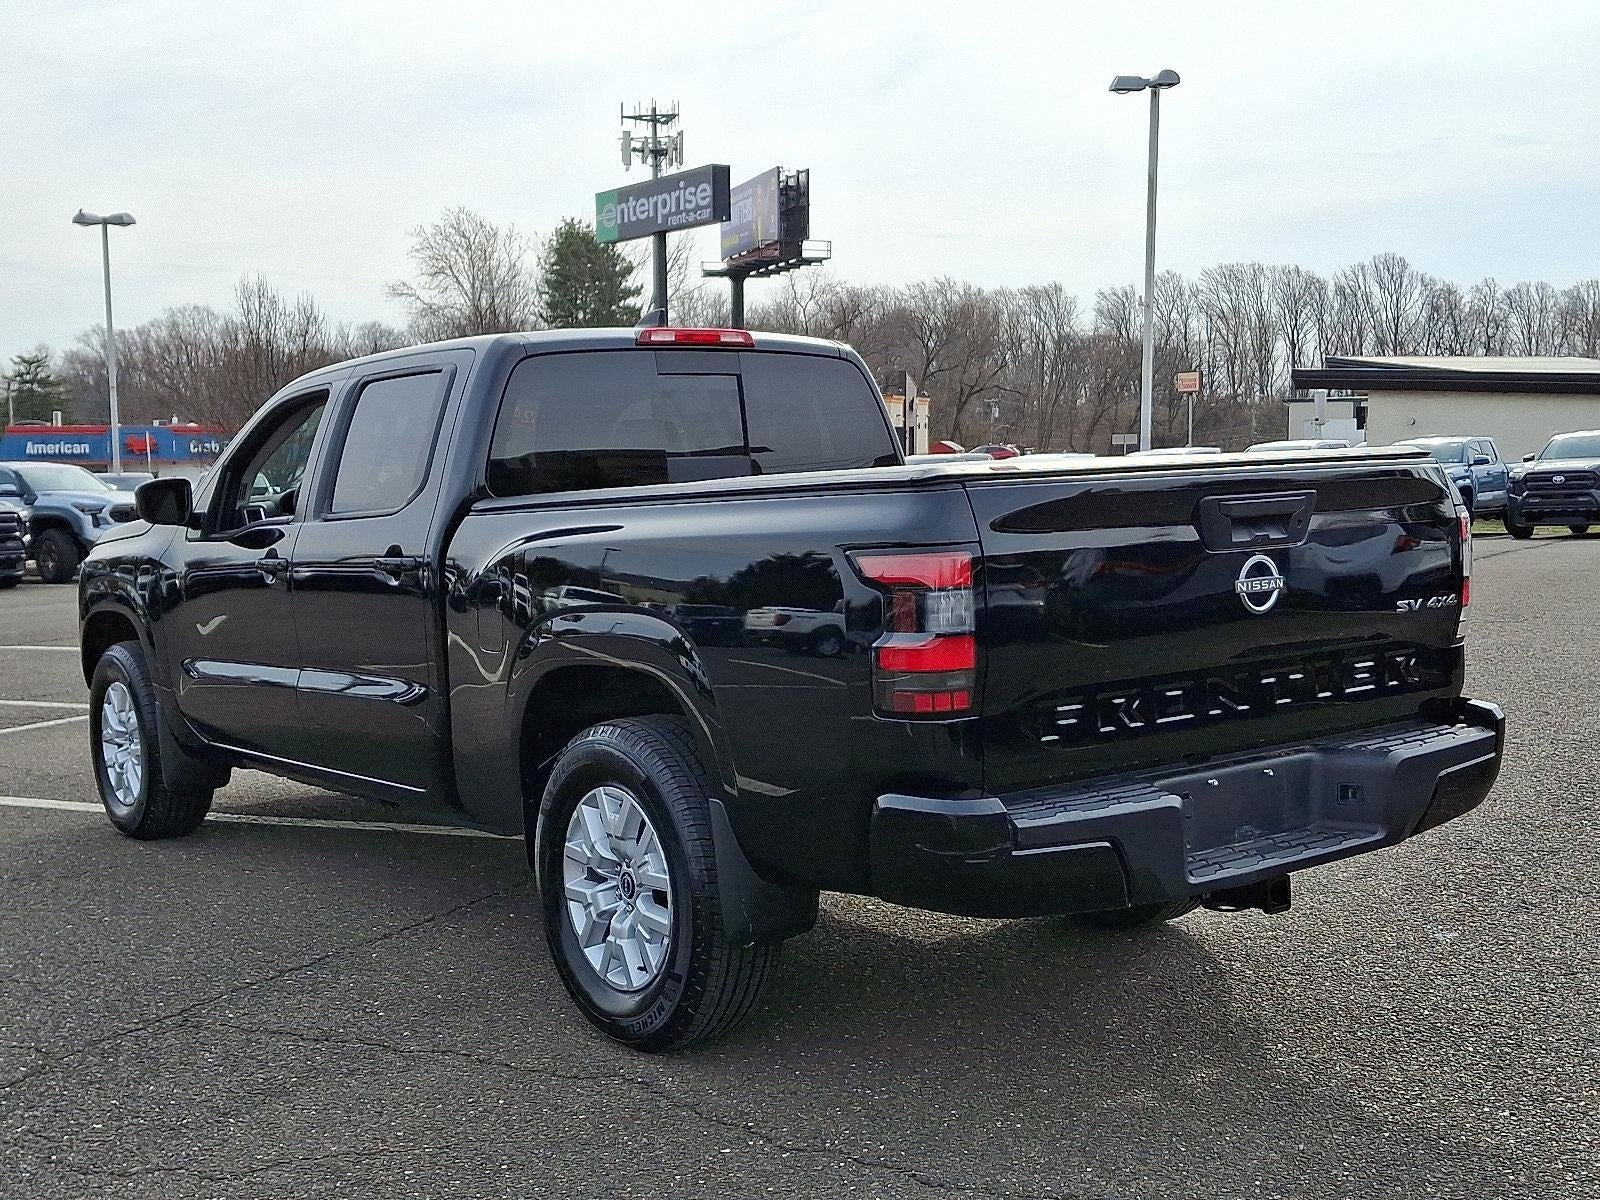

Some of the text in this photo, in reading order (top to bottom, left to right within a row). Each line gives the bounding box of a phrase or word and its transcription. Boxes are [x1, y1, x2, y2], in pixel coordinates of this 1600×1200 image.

[598, 180, 711, 228] enterprise
[668, 208, 712, 226] rent-a-car
[25, 441, 90, 455] American
[1237, 578, 1284, 592] NISSAN
[1396, 598, 1423, 614] SV
[1039, 650, 1422, 742] FRONTIER
